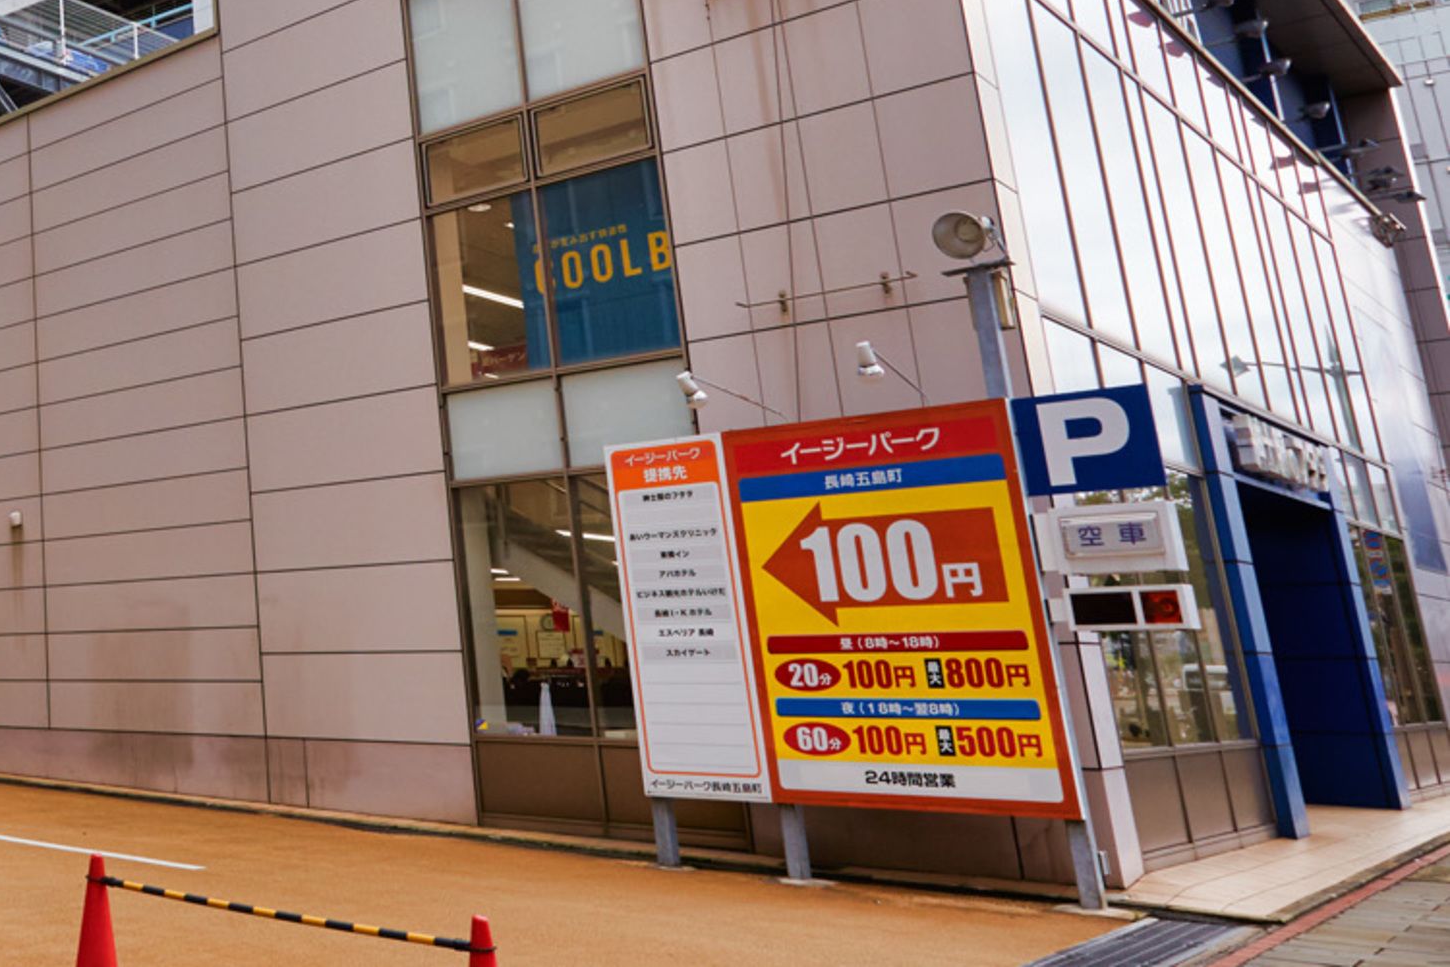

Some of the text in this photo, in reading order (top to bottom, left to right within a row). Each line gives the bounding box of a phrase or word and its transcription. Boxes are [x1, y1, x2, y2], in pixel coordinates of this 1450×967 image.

[781, 427, 939, 464] イージーパーク
[1036, 397, 1130, 486] P
[624, 447, 701, 467] イージーパーク
[643, 465, 688, 483] 提携先
[824, 468, 903, 490] 長崎五島町
[1078, 522, 1146, 546] 空車
[800, 519, 983, 602] 100円
[788, 662, 832, 688] 20分
[842, 659, 917, 690] 100円
[945, 657, 1031, 690] 800円
[796, 725, 842, 752] 60分
[852, 725, 928, 756] 100円
[956, 726, 1043, 758] 500円
[864, 769, 956, 788] 24時間営業
